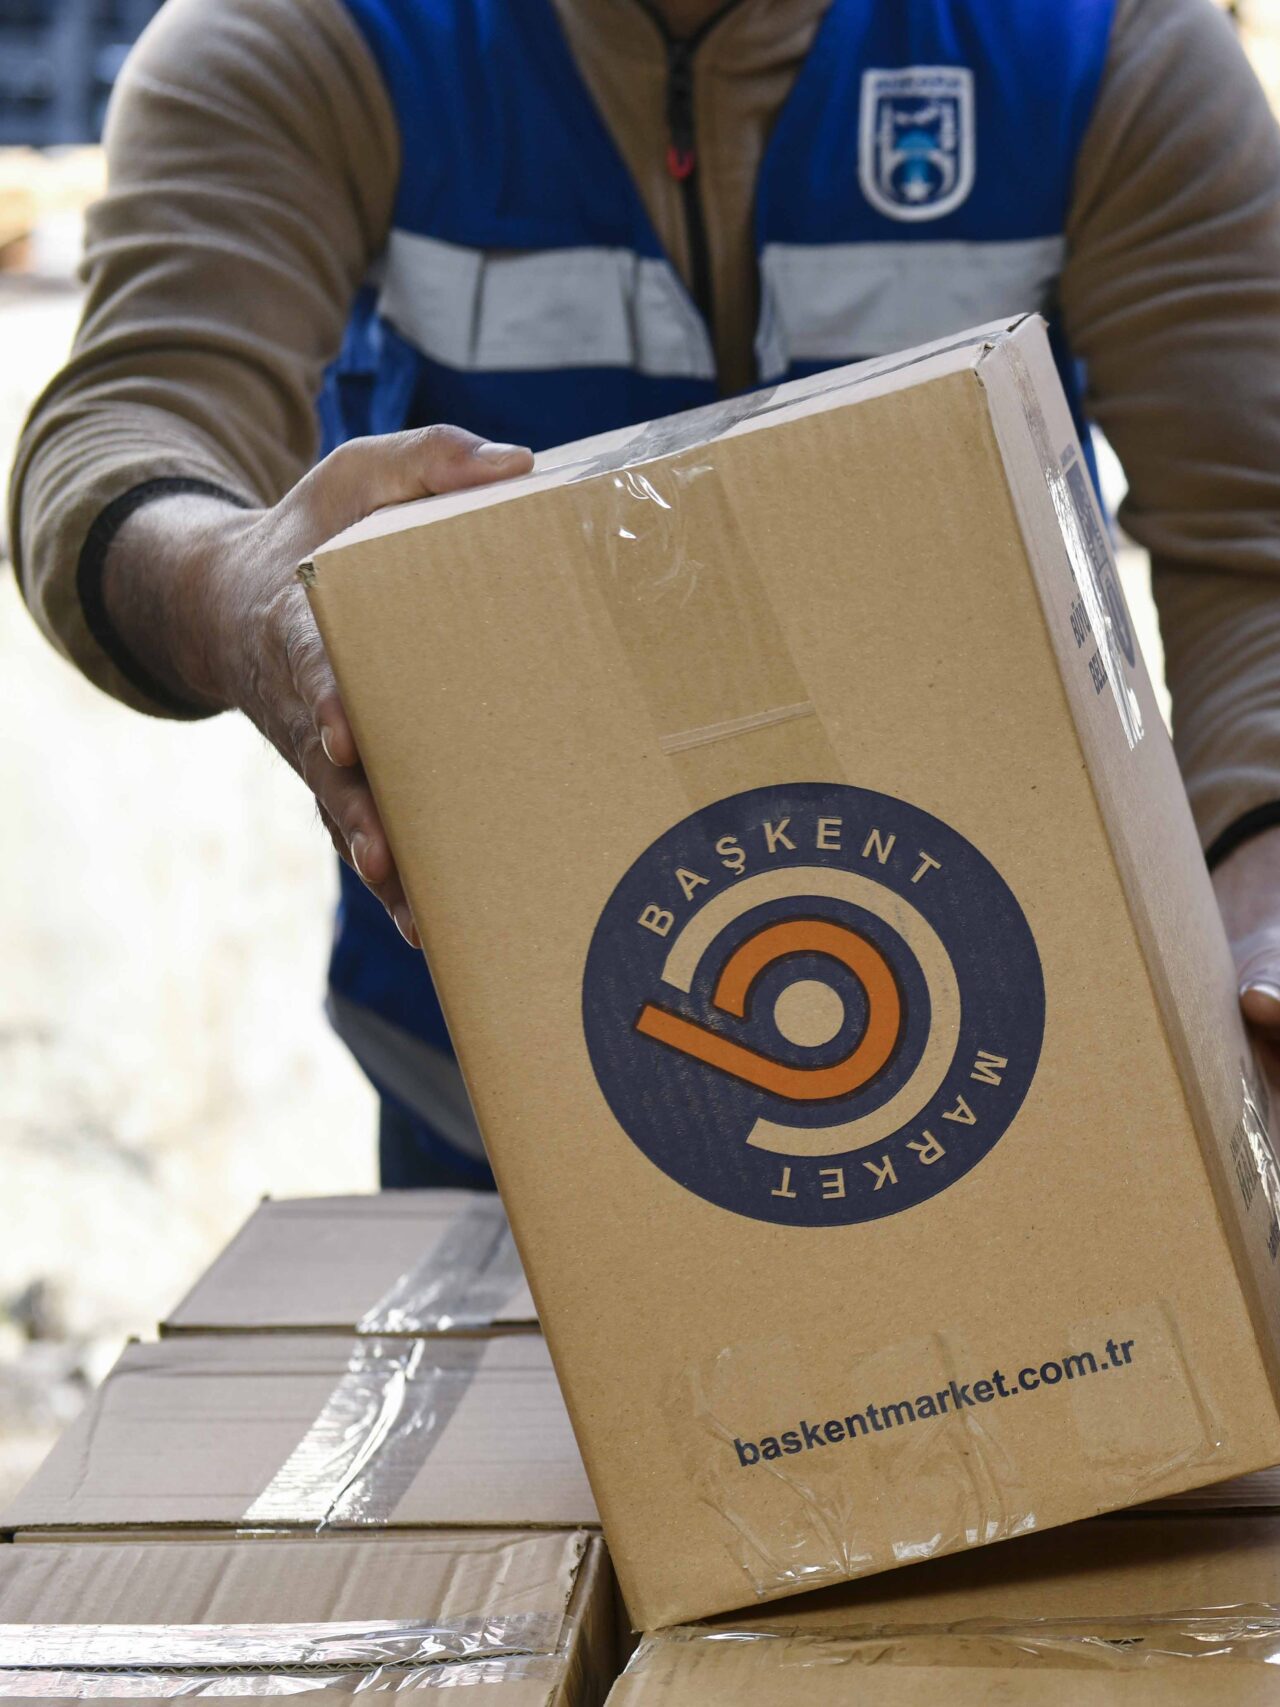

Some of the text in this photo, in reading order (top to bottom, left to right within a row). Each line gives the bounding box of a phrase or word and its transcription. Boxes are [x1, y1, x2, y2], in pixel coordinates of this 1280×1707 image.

[637, 817, 941, 938] BAŞKENT
[771, 1050, 1008, 1200] MARKET
[734, 1339, 1134, 1467] baskentmarket.com.tr
